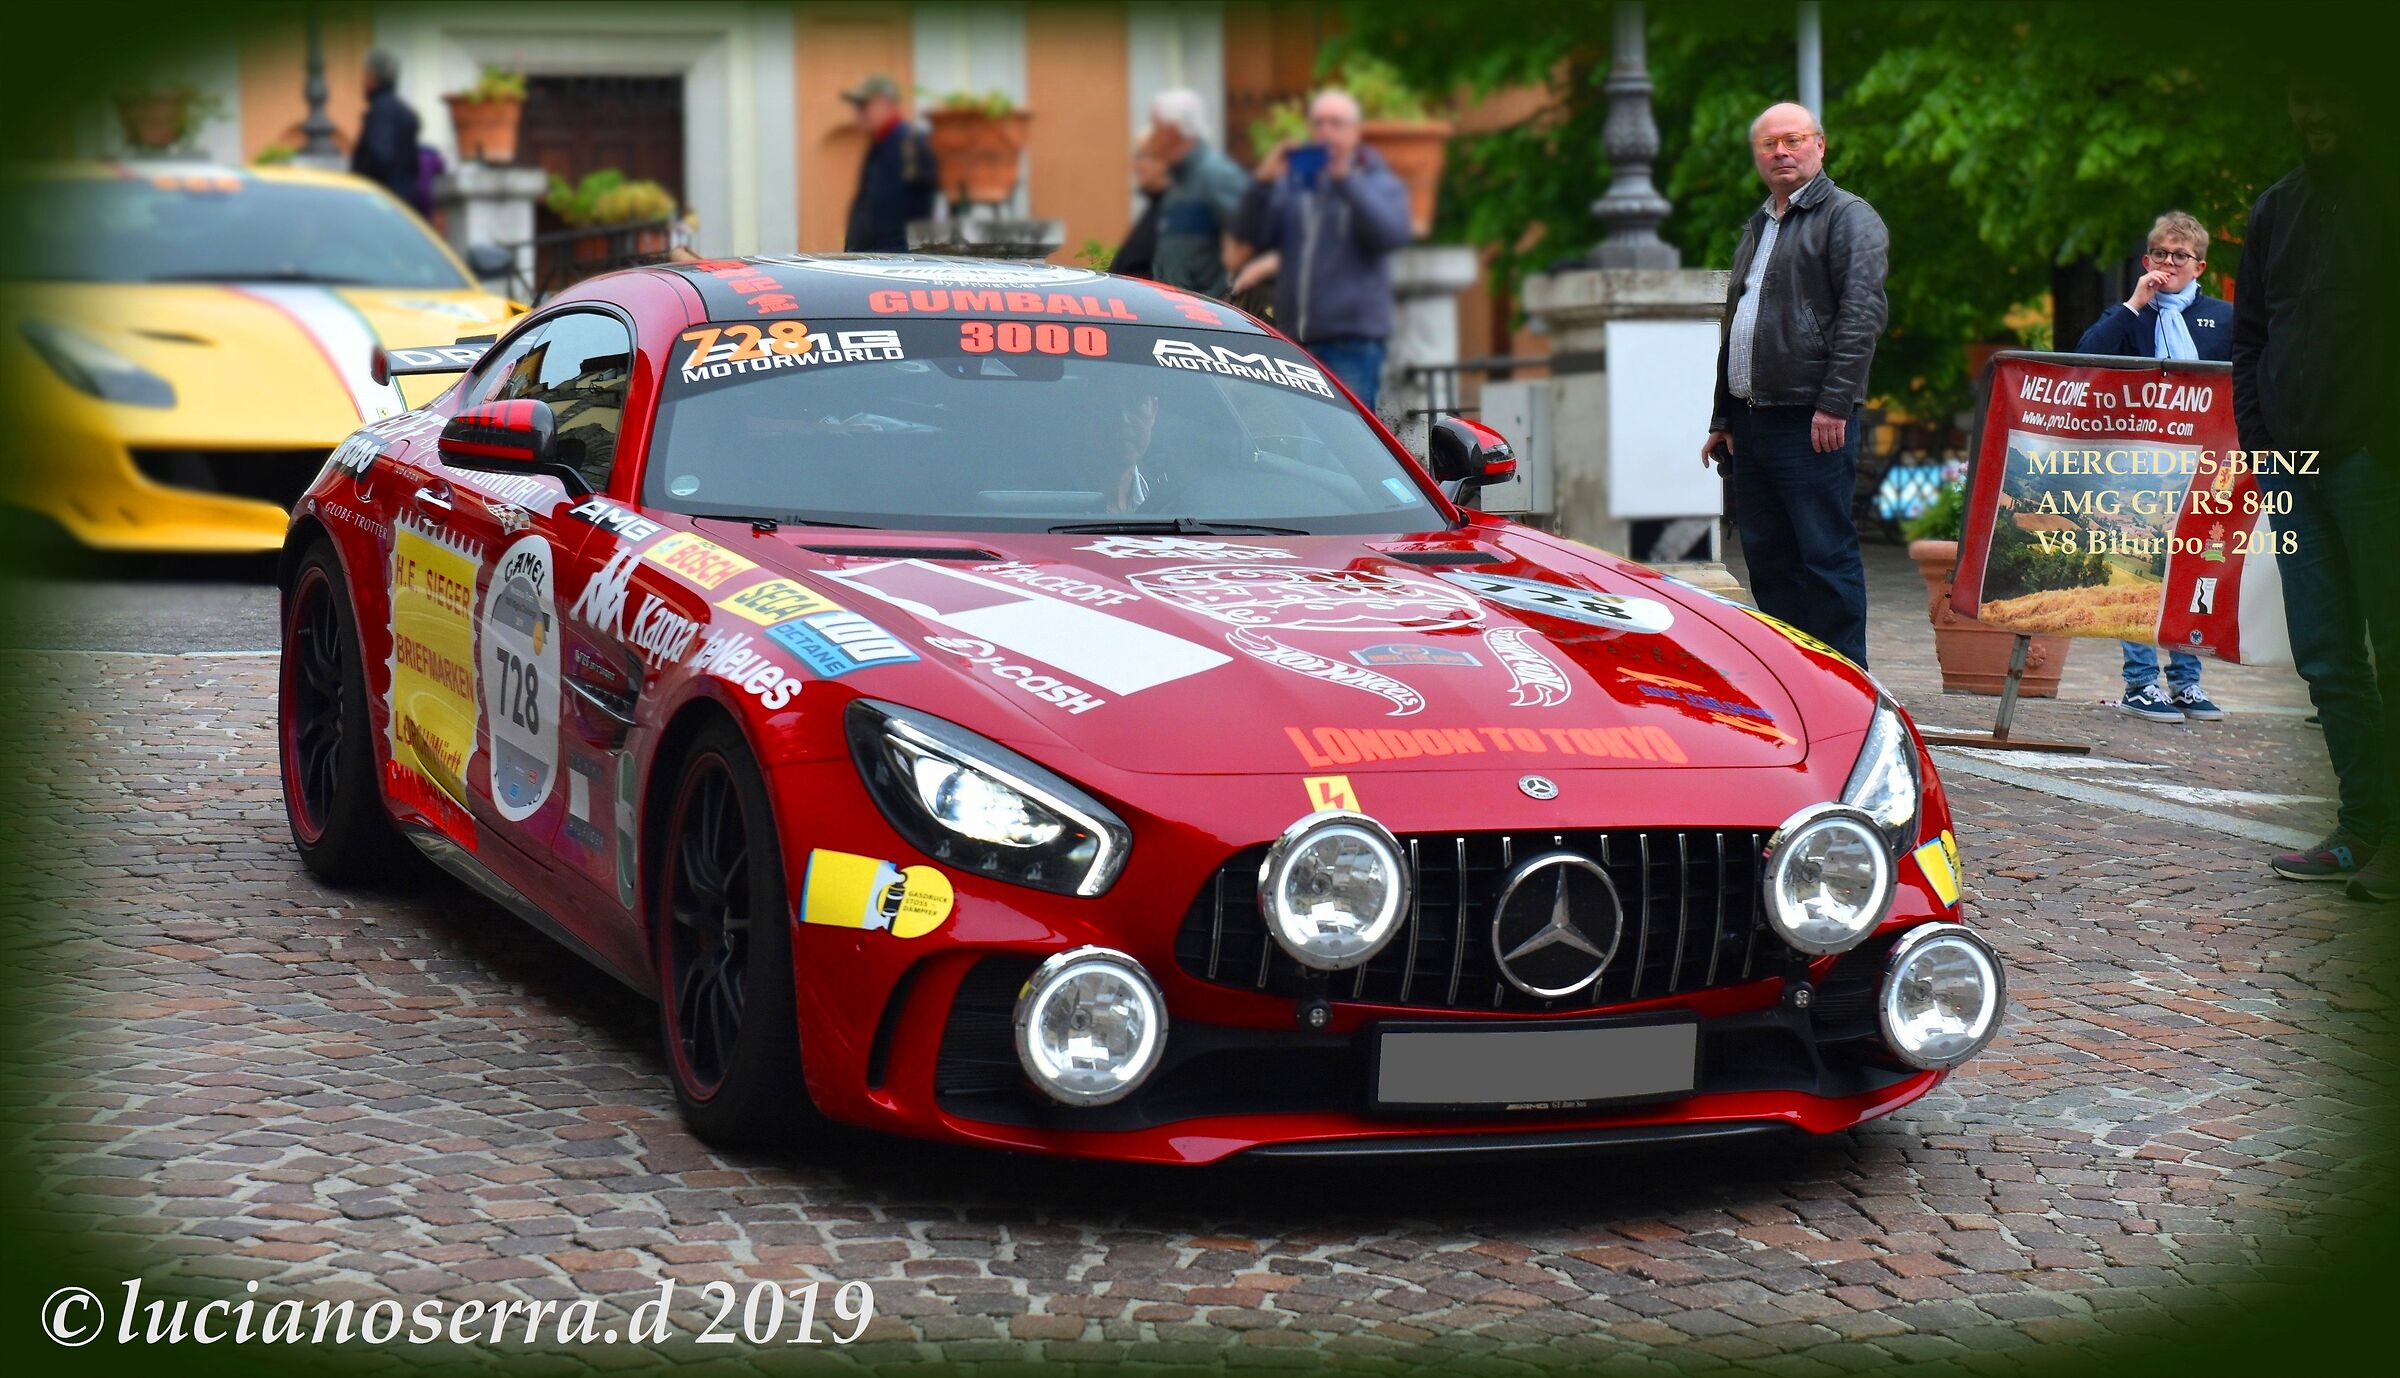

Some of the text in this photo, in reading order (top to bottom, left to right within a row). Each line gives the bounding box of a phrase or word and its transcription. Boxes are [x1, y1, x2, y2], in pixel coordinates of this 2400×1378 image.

[868, 290, 1138, 323] GUMBALL
[390, 347, 489, 367] DR
[682, 320, 812, 366] 728
[959, 322, 1107, 357] 3000
[682, 345, 904, 383] MOTORWORLD
[1152, 338, 1328, 387] AMG
[1154, 354, 1335, 399] MOTORWORLD
[2020, 375, 2213, 413] WELCOME TO LOIANO
[2022, 410, 2194, 437] www.prolocoloiano.com
[443, 465, 560, 507] OTORWORLD
[325, 500, 388, 541] GLOBE-TROTTER
[568, 500, 663, 541] AMG
[665, 543, 744, 587] BOSCH
[1004, 565, 1142, 607] FACEOFF
[396, 554, 418, 593] H.E.
[426, 569, 470, 620] SIEGER
[734, 583, 817, 622] SECA
[1469, 578, 1633, 620] 728
[629, 593, 700, 670] Kappa
[774, 624, 847, 674] OCTANE
[396, 632, 474, 702] BRIEFMARKEN
[687, 630, 803, 710] teNeues
[497, 646, 540, 736] 728
[1284, 726, 1688, 768] LONDON TO TOKYO
[905, 898, 928, 907] STOSS
[907, 890, 948, 904] GASDRUCK
